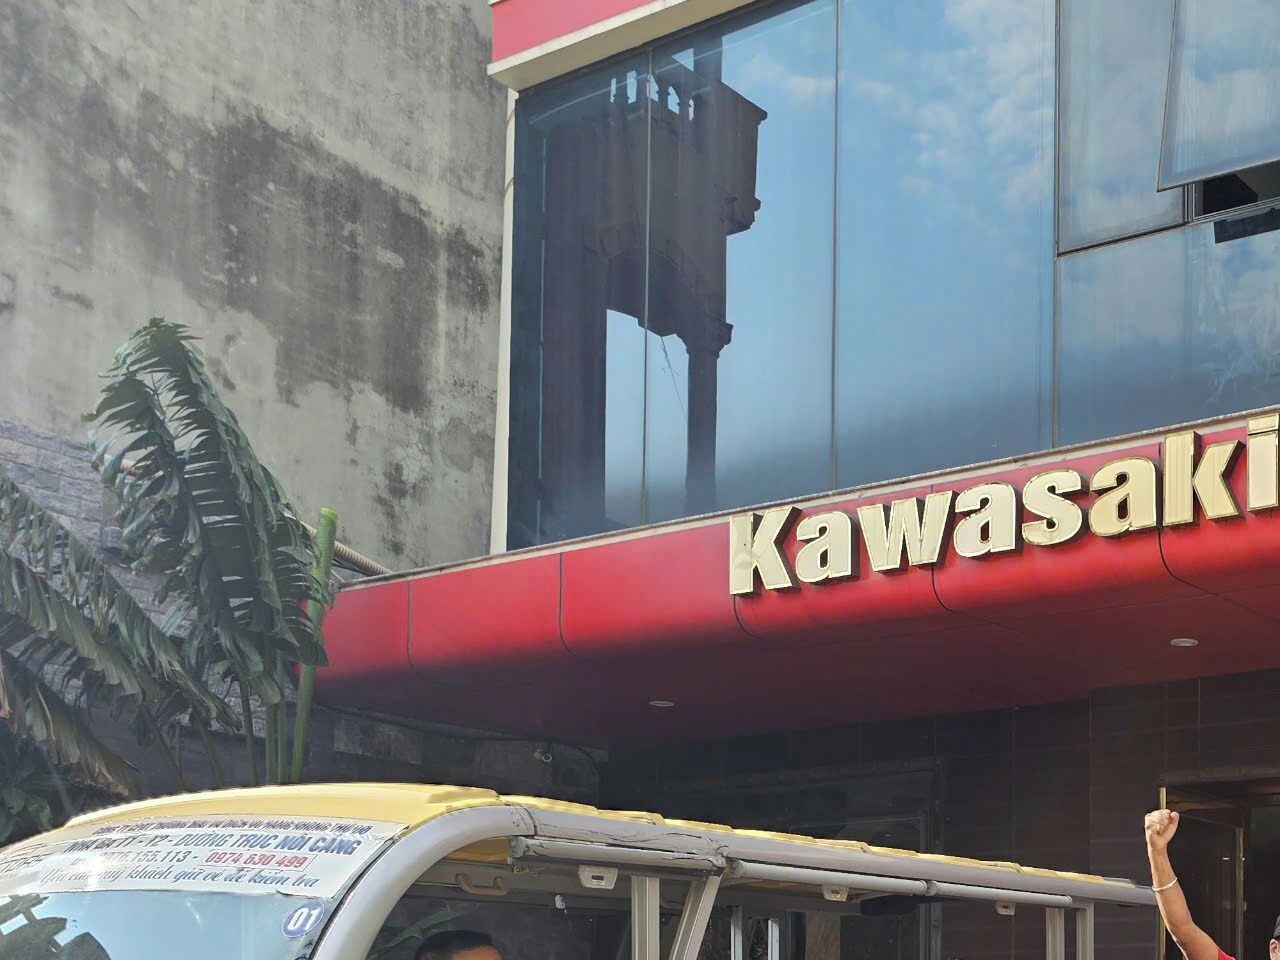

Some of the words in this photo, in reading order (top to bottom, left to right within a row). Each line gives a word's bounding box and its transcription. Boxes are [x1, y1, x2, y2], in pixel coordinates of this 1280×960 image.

[204, 851, 244, 865] 0974
[243, 853, 276, 866] 630
[274, 855, 310, 869] 499
[287, 907, 321, 931] 01
